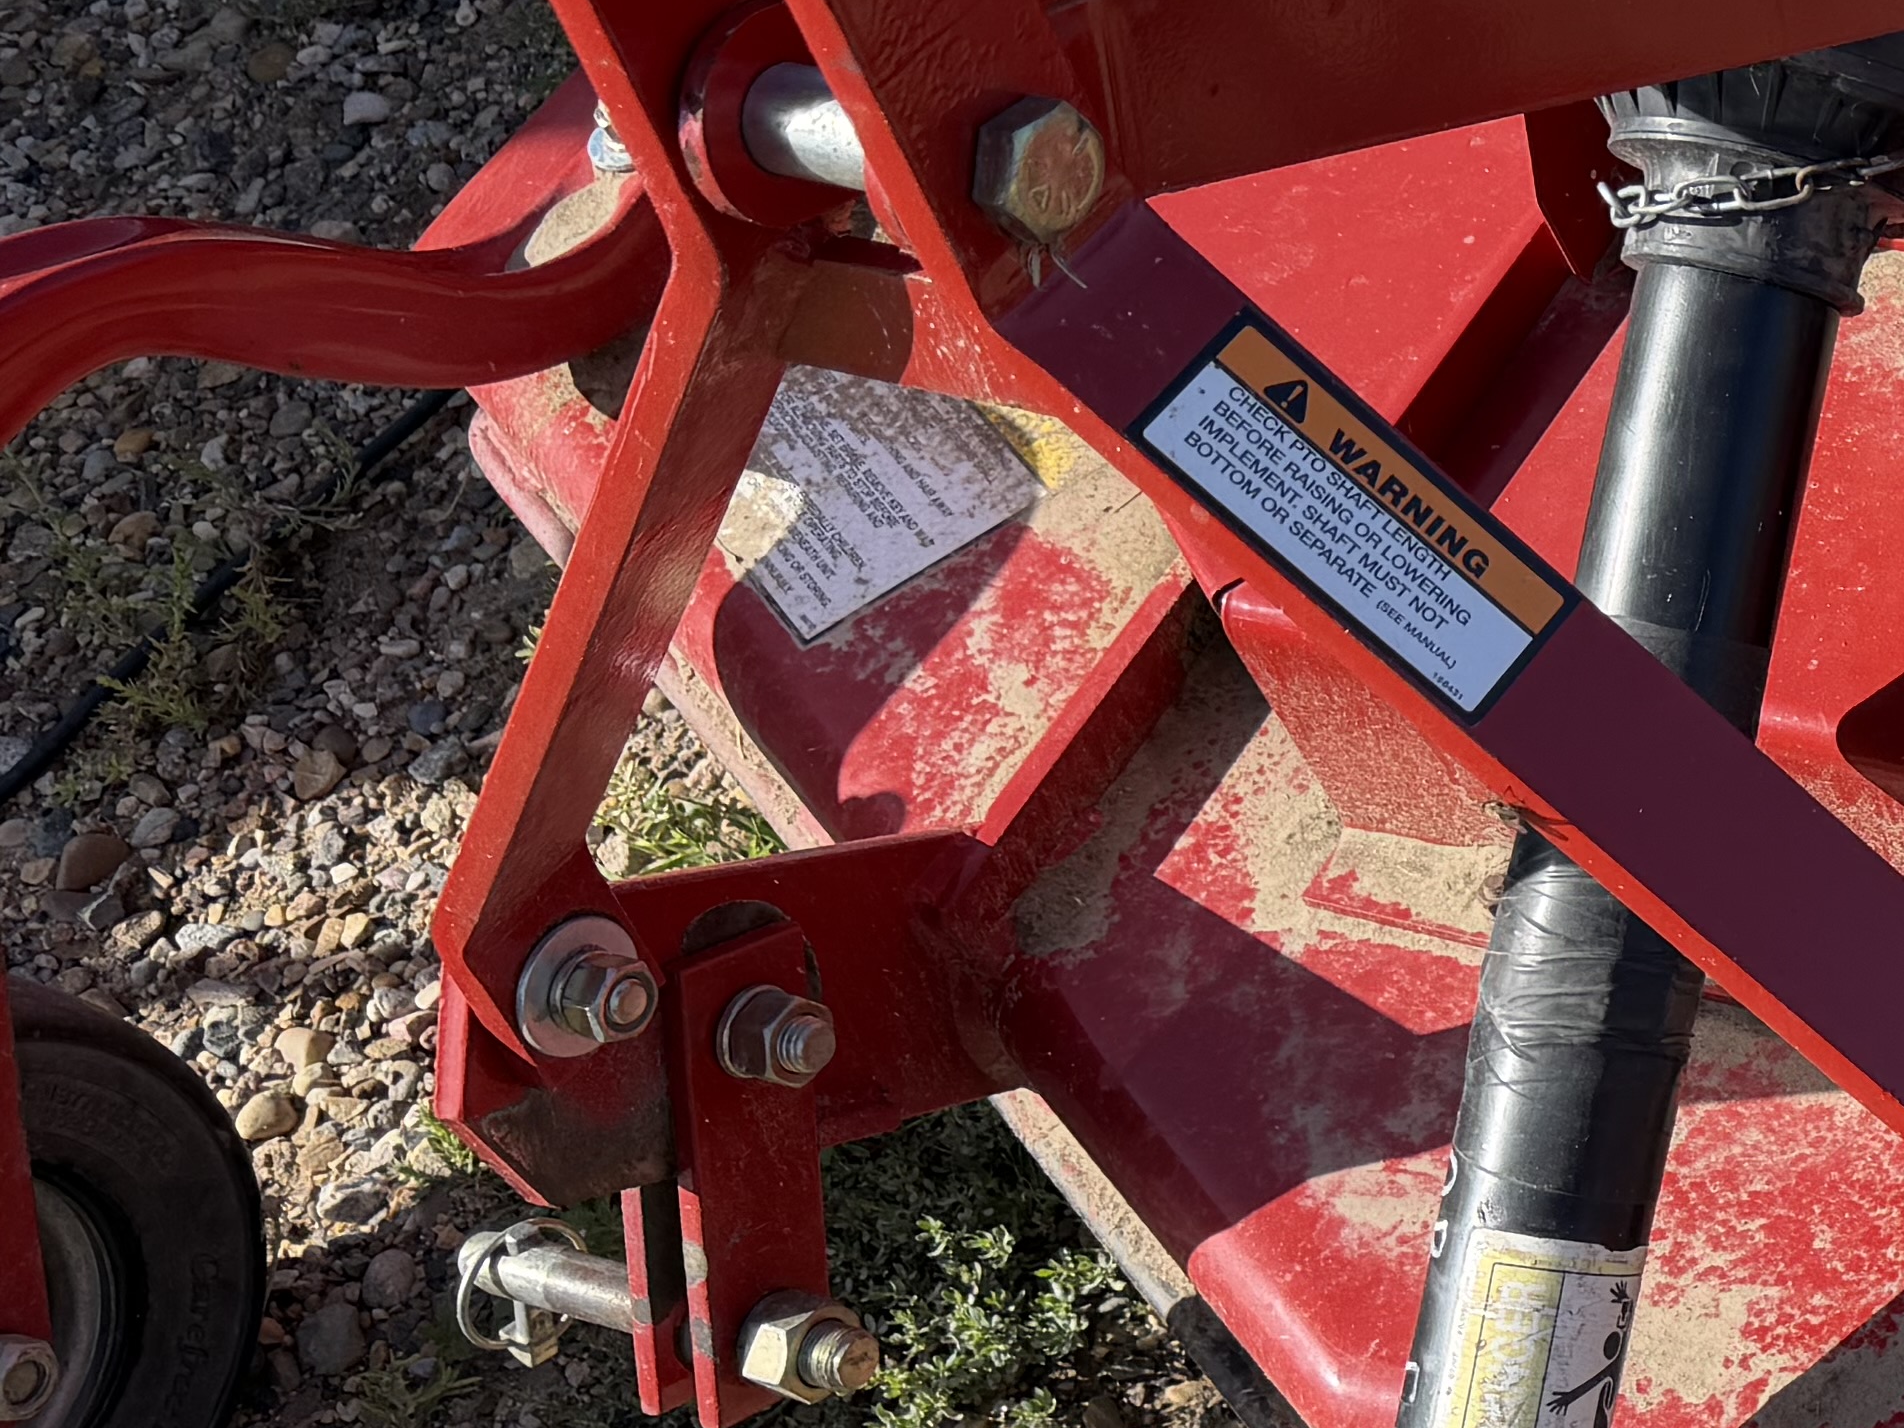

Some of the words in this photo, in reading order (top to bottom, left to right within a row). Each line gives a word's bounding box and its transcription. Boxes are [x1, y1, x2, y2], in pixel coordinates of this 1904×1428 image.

[843, 466, 859, 481] TO
[851, 475, 876, 501] STOP
[867, 495, 901, 530] BEFORE
[860, 466, 894, 502] REMOVE
[885, 496, 907, 517] KEY
[897, 510, 920, 532] AND
[900, 460, 921, 482] AND
[913, 476, 937, 499] HAIR
[1182, 429, 1263, 500] BOTTOM
[1259, 495, 1290, 525] OR
[1287, 519, 1378, 599] SEPARATE
[1211, 399, 1287, 466] BEFORE
[1281, 460, 1354, 526] RAISING
[1353, 521, 1383, 551] OR
[1379, 543, 1472, 627] LOWERING
[1227, 385, 1292, 444] CHECK
[1287, 437, 1327, 474] PTO
[1325, 470, 1385, 521] SHAFT
[1380, 517, 1452, 582] LENGTH
[1327, 427, 1490, 580] WARNING
[864, 509, 886, 530] AND
[1197, 414, 1304, 510] IMPLEMENT.
[1300, 503, 1362, 555] SHAFT
[1356, 551, 1412, 598] MUST
[1406, 594, 1450, 630] NOT
[787, 558, 807, 575] OR
[796, 570, 835, 609] STORING.
[1374, 598, 1406, 626] (SEE
[1401, 620, 1457, 671] MANUAL)
